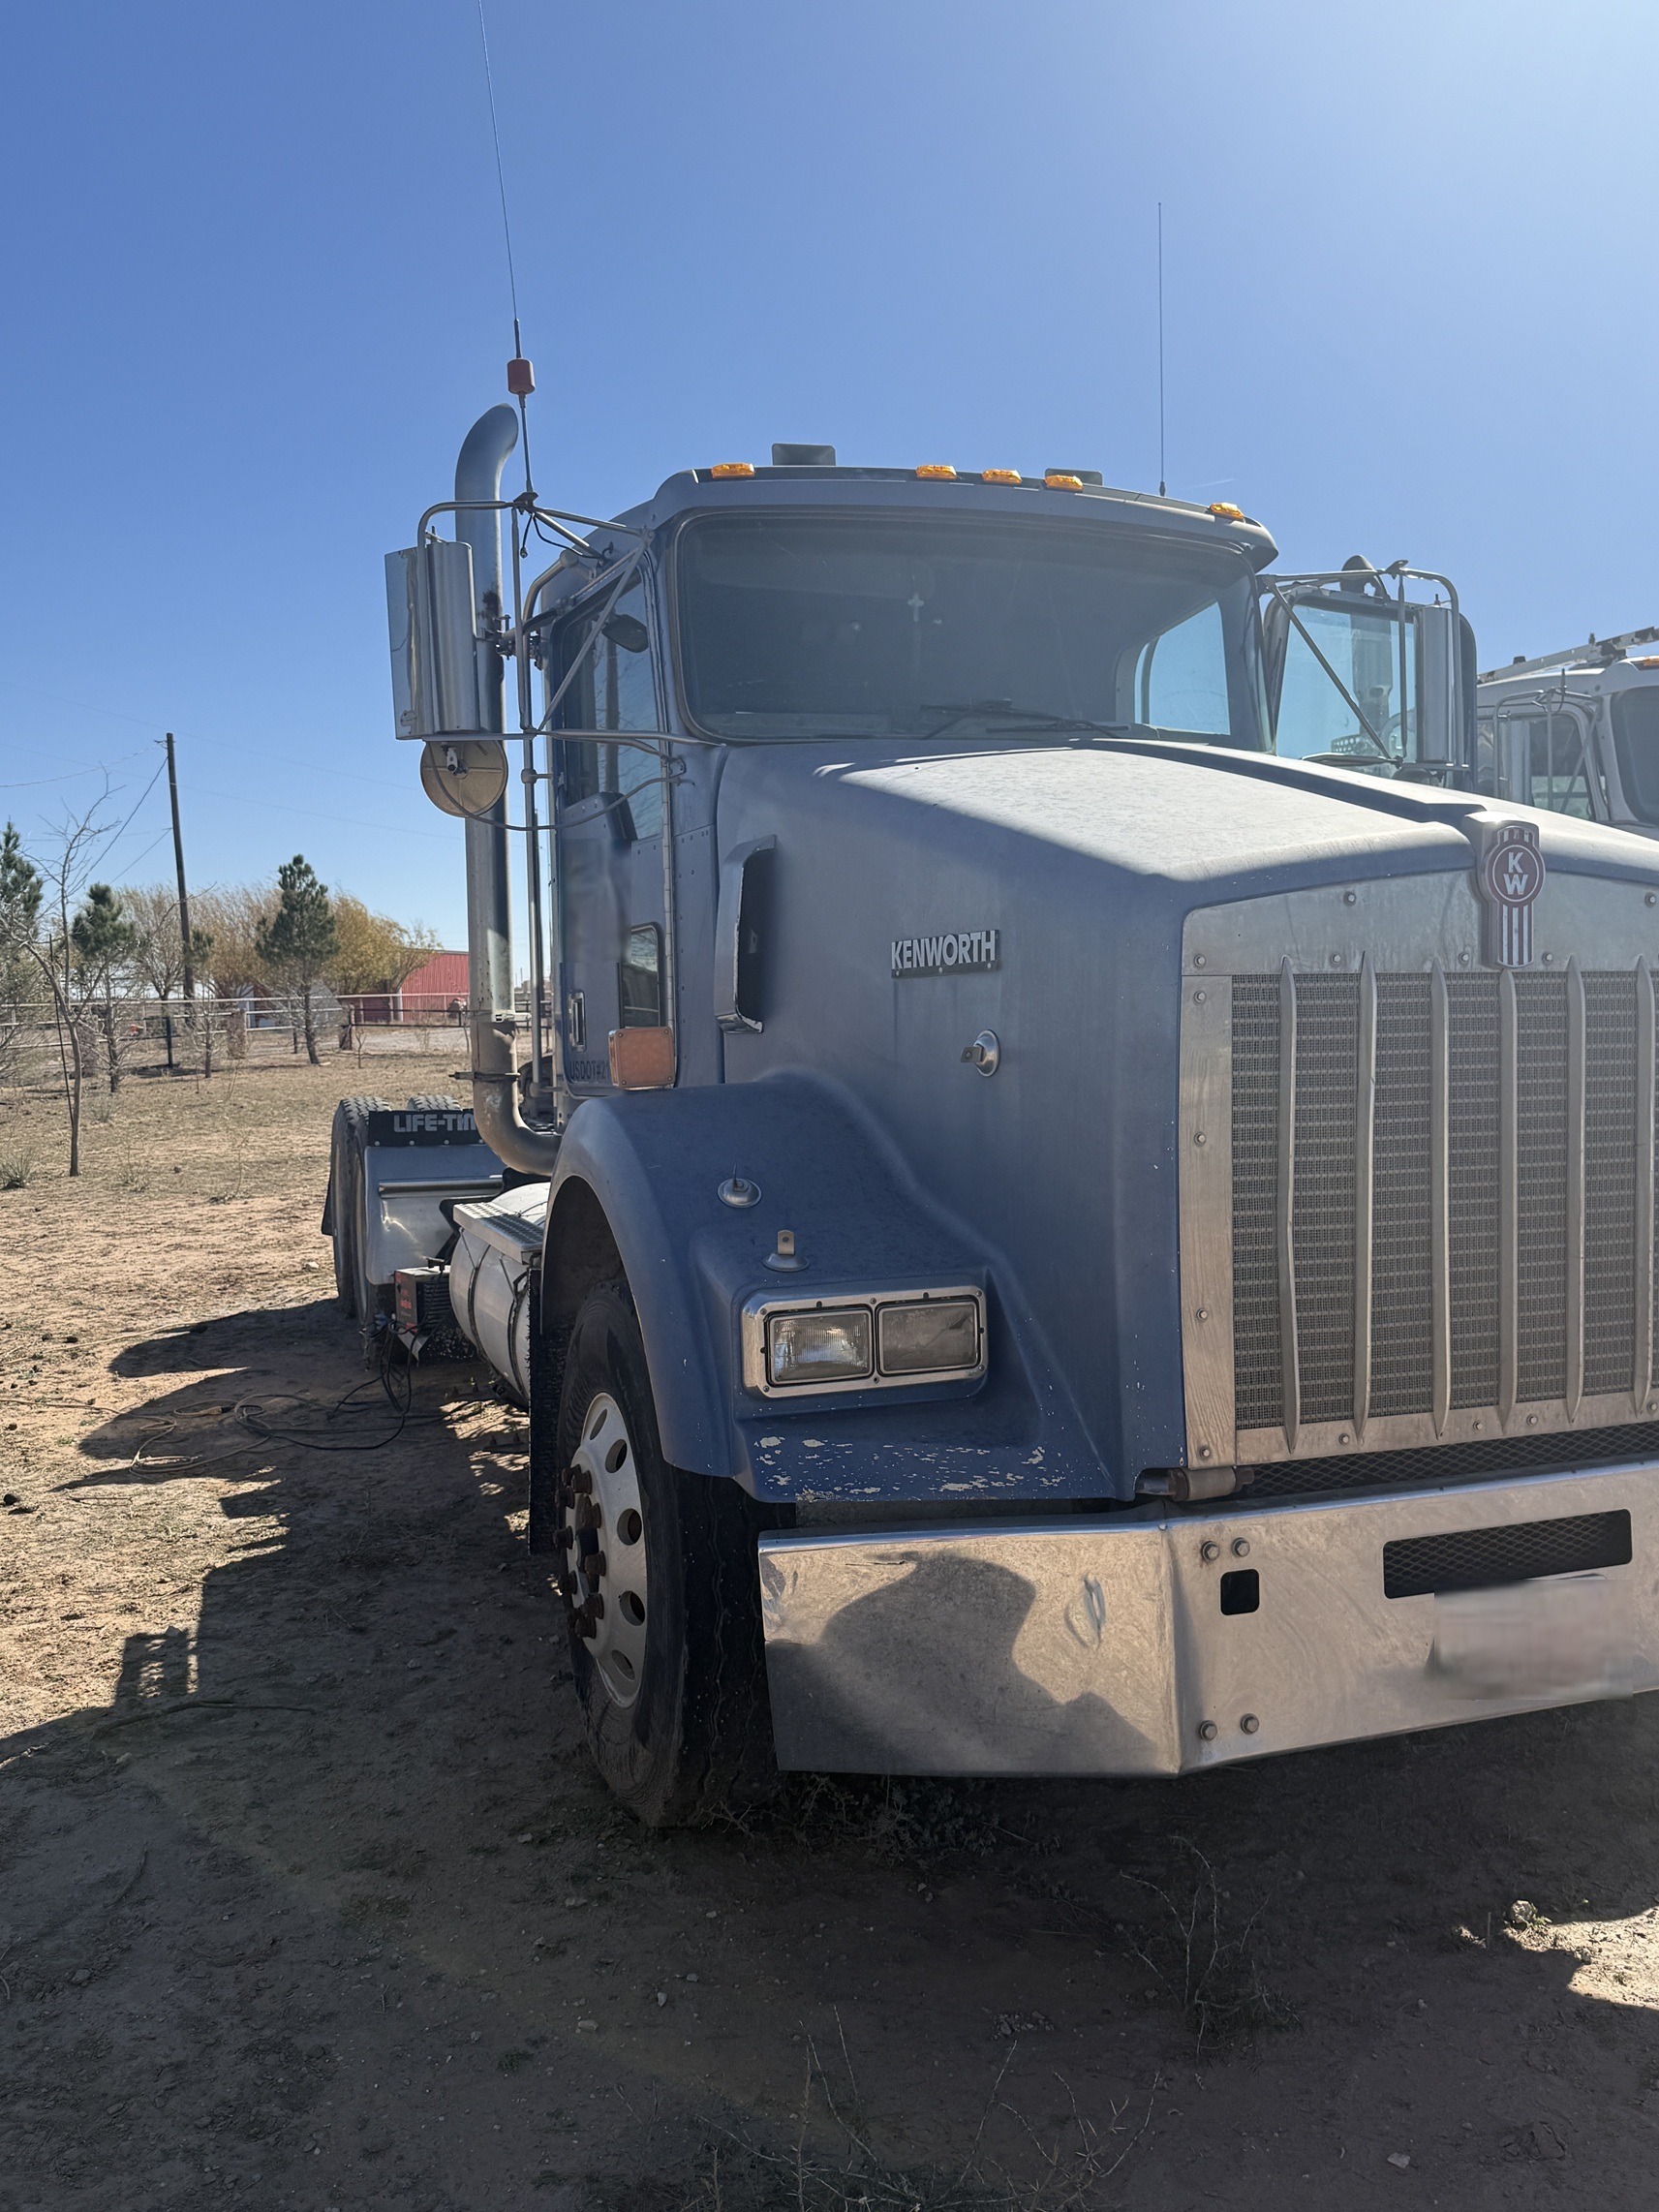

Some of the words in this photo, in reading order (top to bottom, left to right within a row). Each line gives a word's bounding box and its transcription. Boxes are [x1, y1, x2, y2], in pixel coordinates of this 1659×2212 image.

[1508, 851, 1523, 874] K
[1503, 874, 1528, 895] W
[891, 930, 996, 969] KENWORTH
